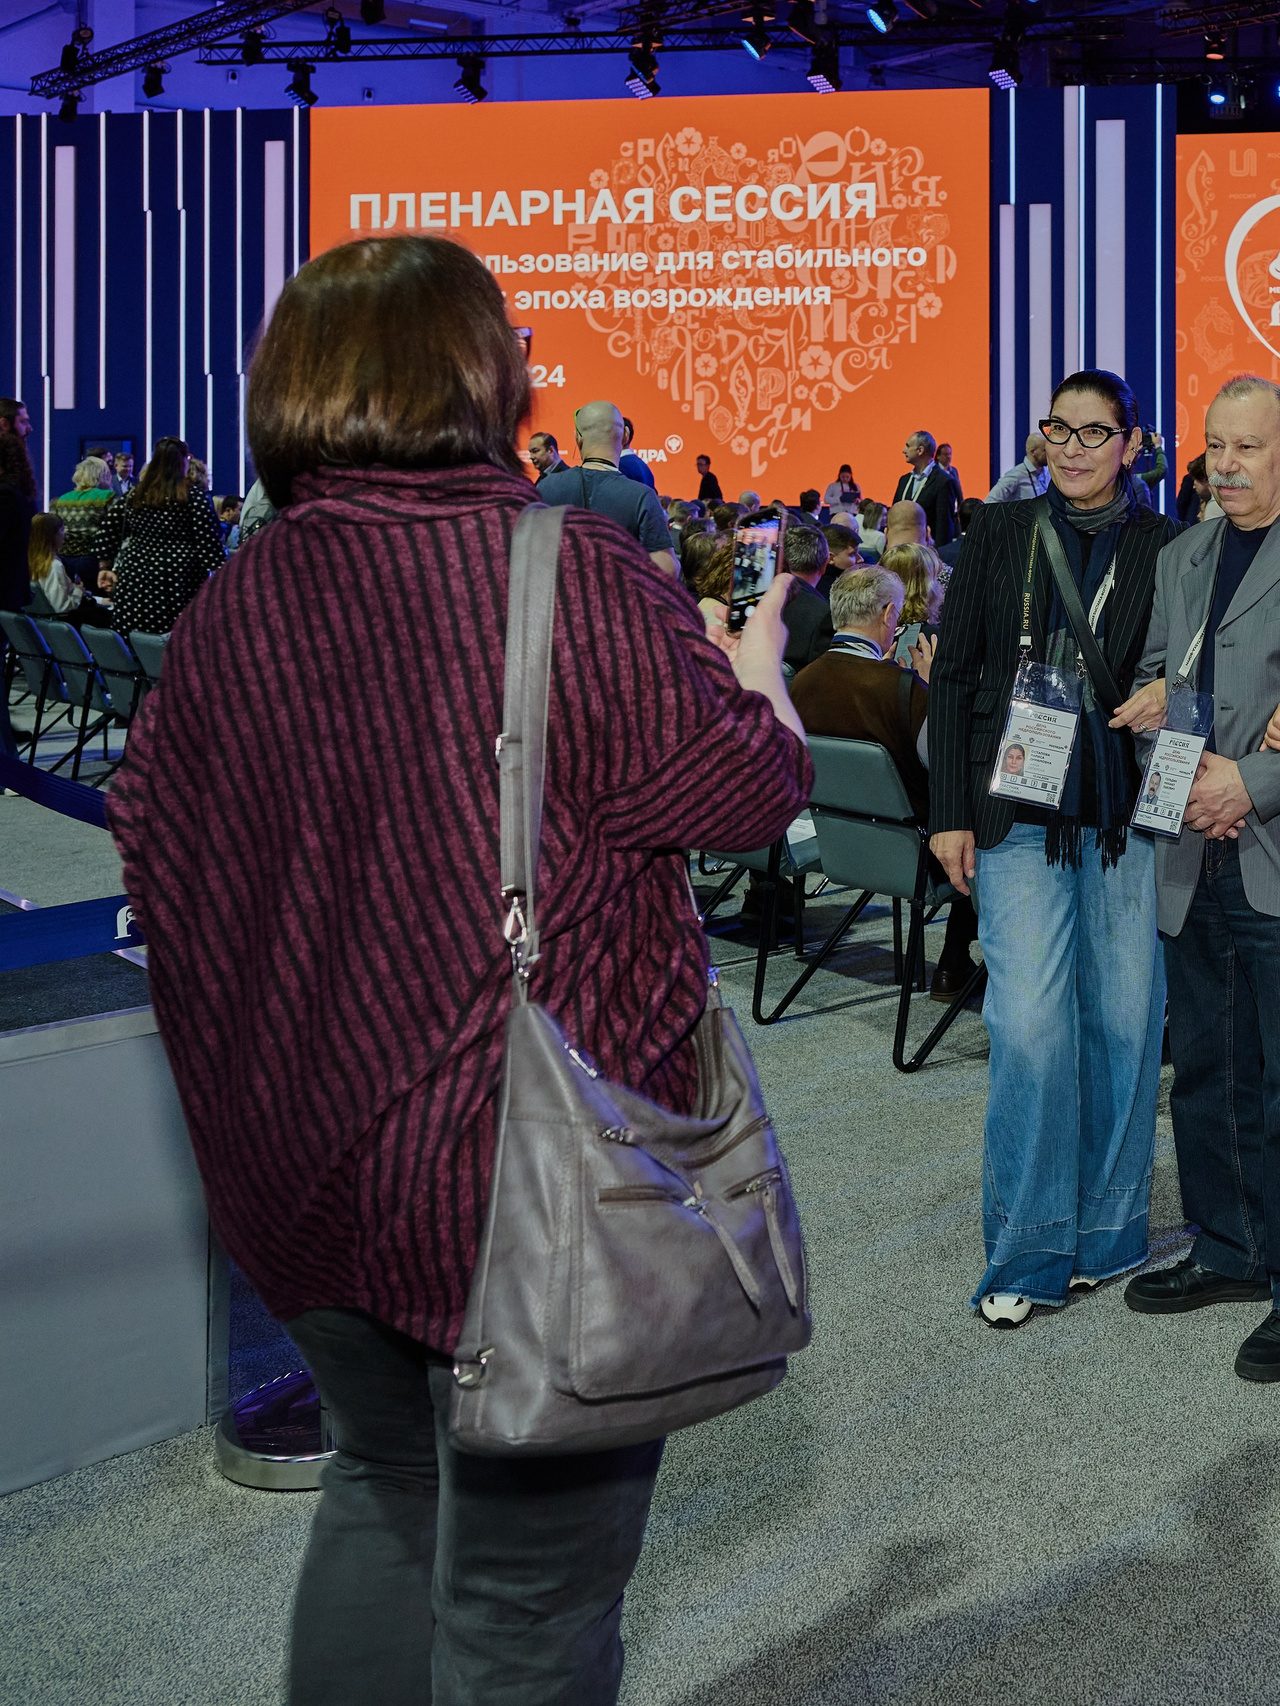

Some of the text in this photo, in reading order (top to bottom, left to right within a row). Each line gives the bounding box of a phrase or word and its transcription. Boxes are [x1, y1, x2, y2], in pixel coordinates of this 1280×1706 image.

[350, 182, 877, 229] ПЛЕНАРНАЯ СЕССИЯ
[475, 243, 927, 275] льзование для стабильного
[514, 289, 605, 310] эпоха
[613, 285, 832, 315] возрождения
[1022, 592, 1031, 630] RUSSIA.RU
